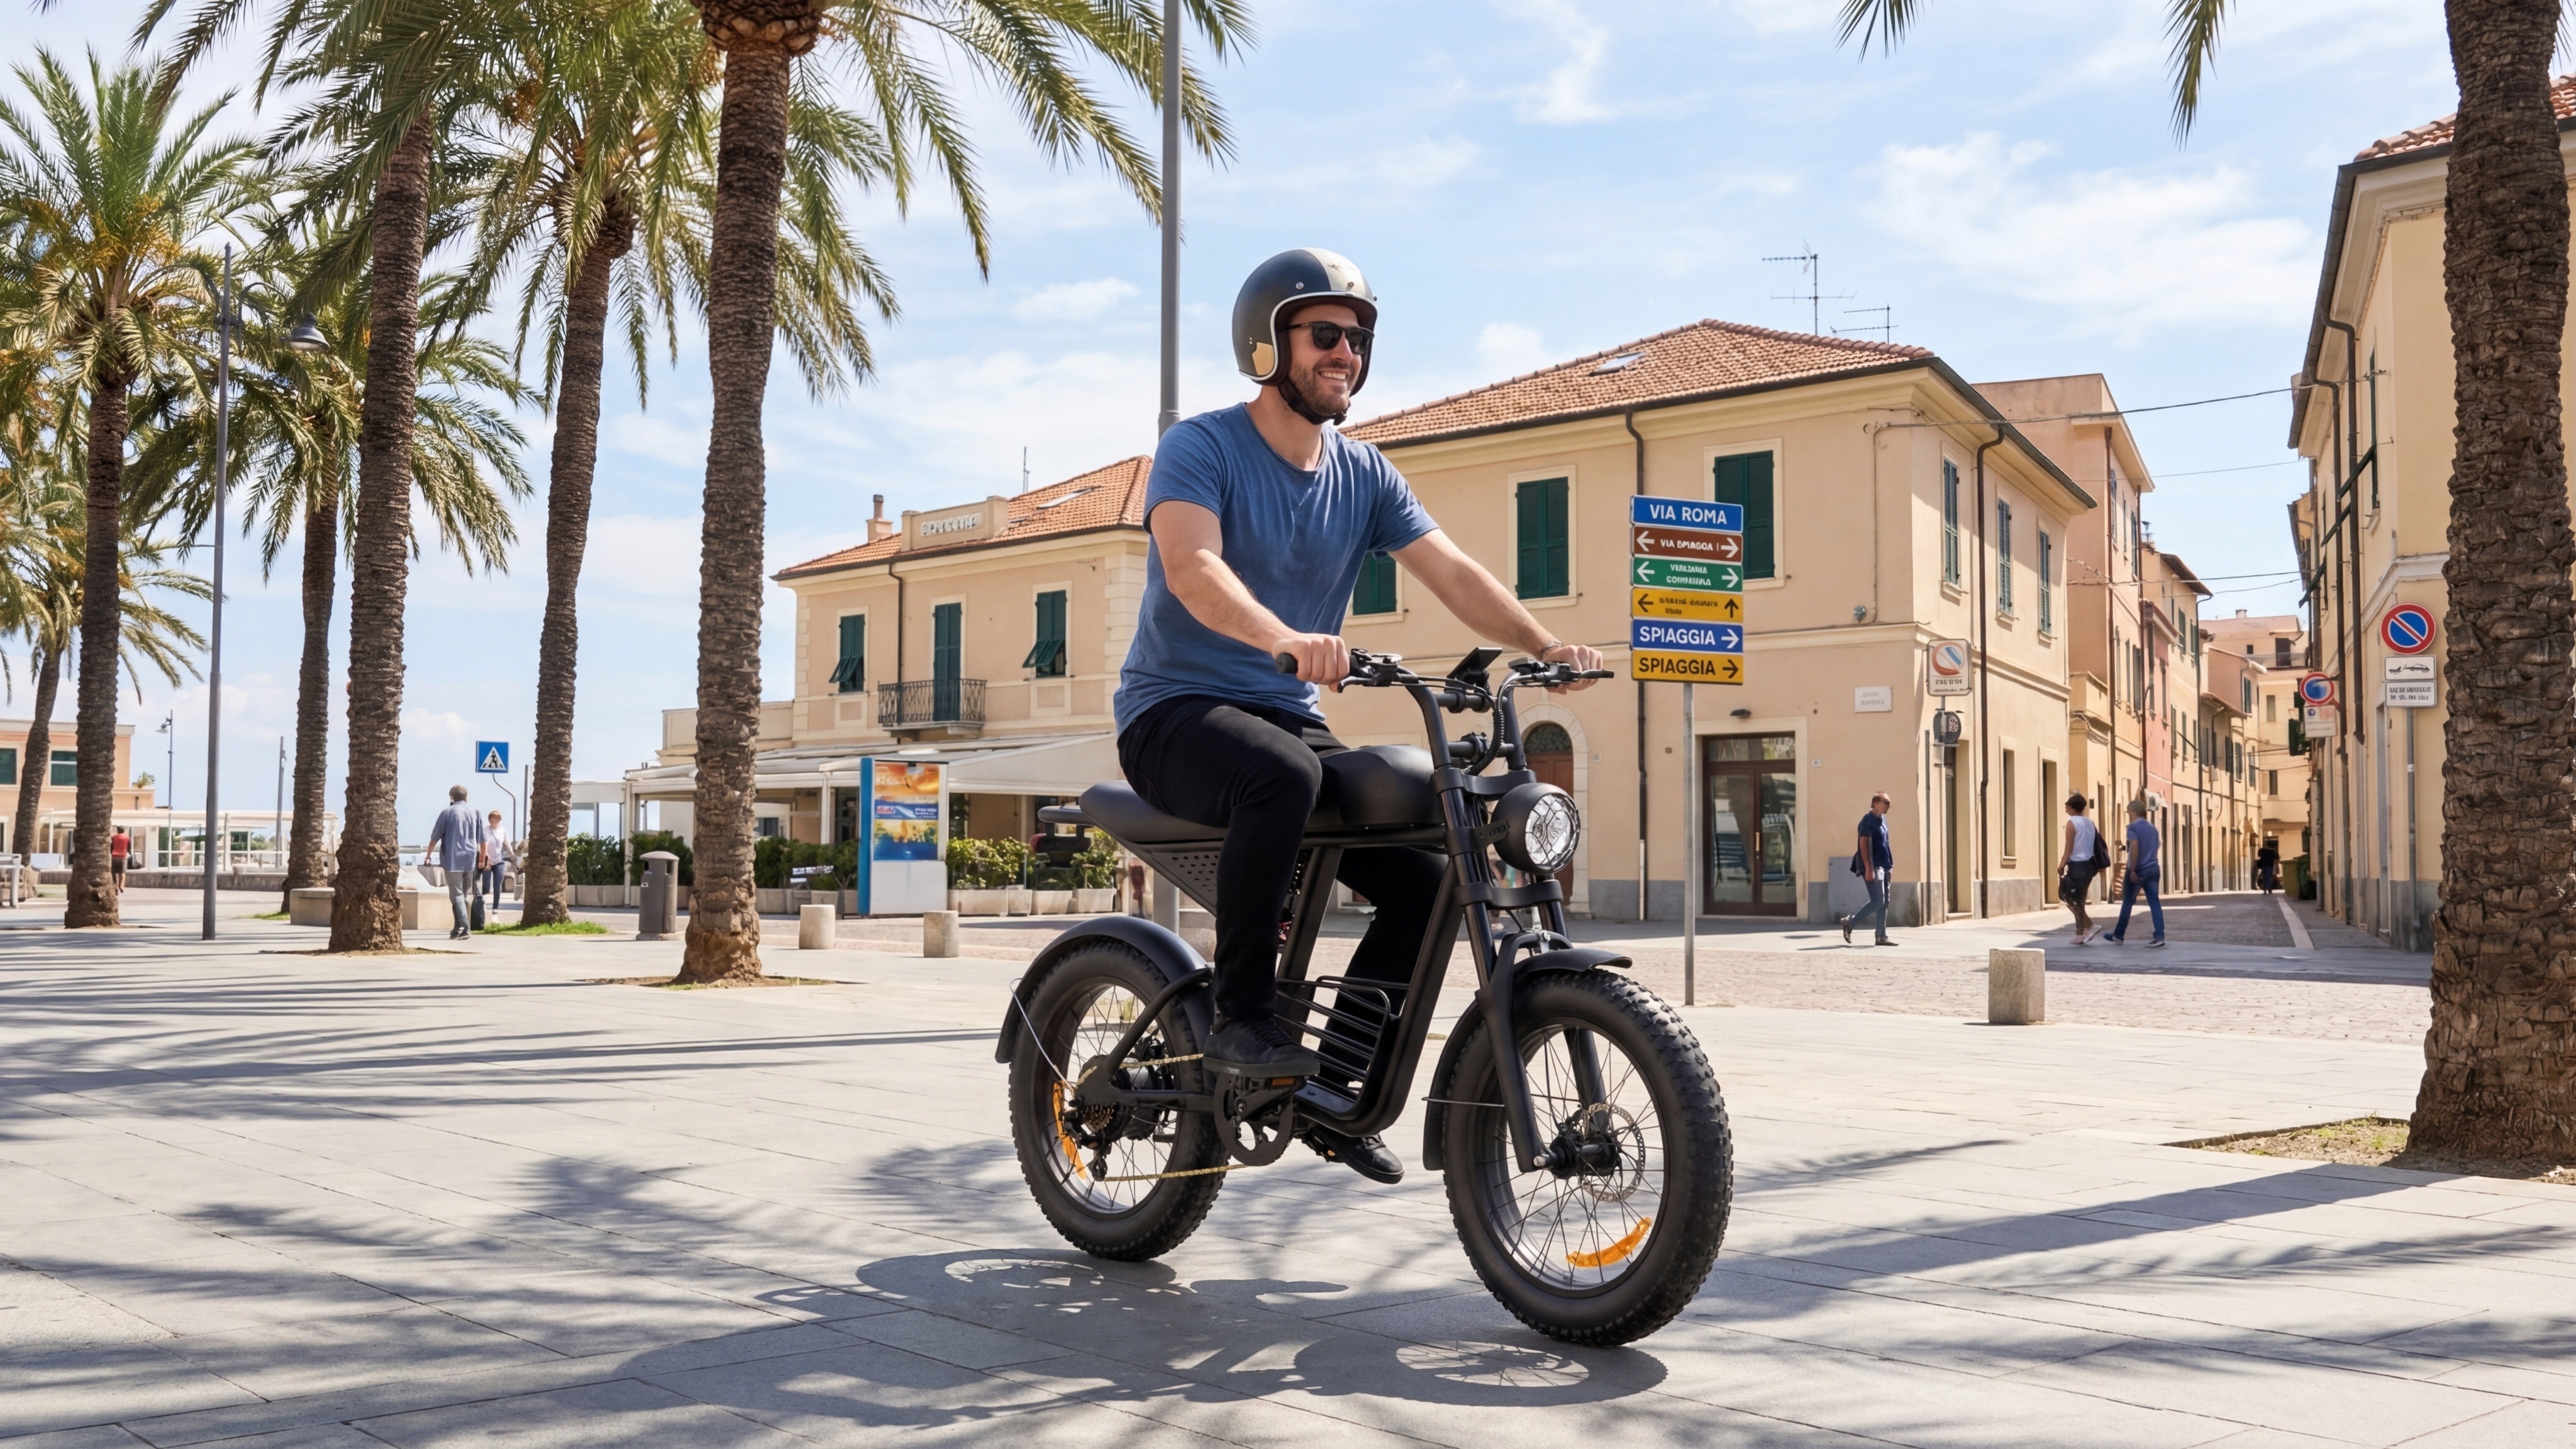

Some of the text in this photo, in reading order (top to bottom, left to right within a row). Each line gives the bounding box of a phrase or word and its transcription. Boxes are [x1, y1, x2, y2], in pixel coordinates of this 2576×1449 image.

[1650, 504, 1727, 525] VIA ROMA
[1660, 539, 1675, 547] VIA
[1640, 626, 1716, 645] SPIAGGIA
[1638, 657, 1716, 675] SPIAGGIA
